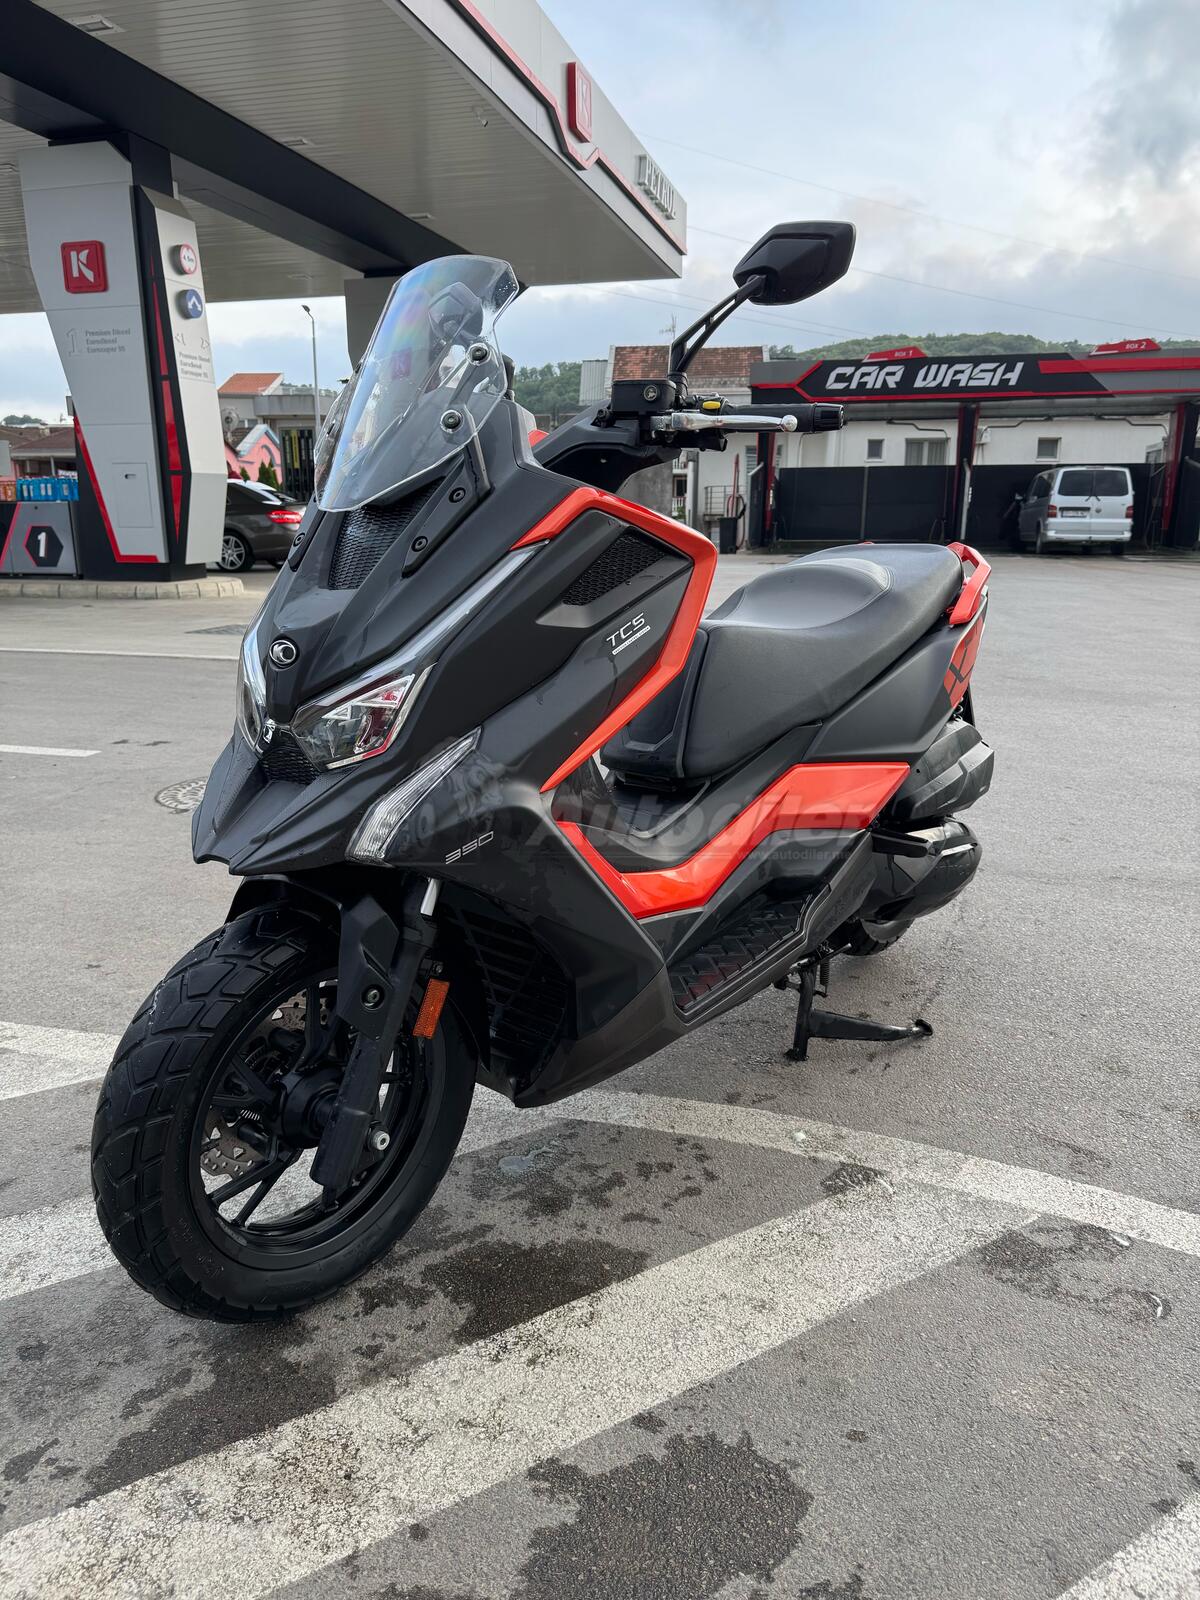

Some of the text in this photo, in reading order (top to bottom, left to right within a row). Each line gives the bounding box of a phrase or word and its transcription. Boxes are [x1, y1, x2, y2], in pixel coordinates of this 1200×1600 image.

[643, 155, 676, 219] PETROL
[70, 249, 95, 283] K
[826, 362, 1025, 390] CAR WASH
[37, 531, 47, 558] 1
[606, 612, 645, 647] TCS
[445, 831, 494, 865] 350
